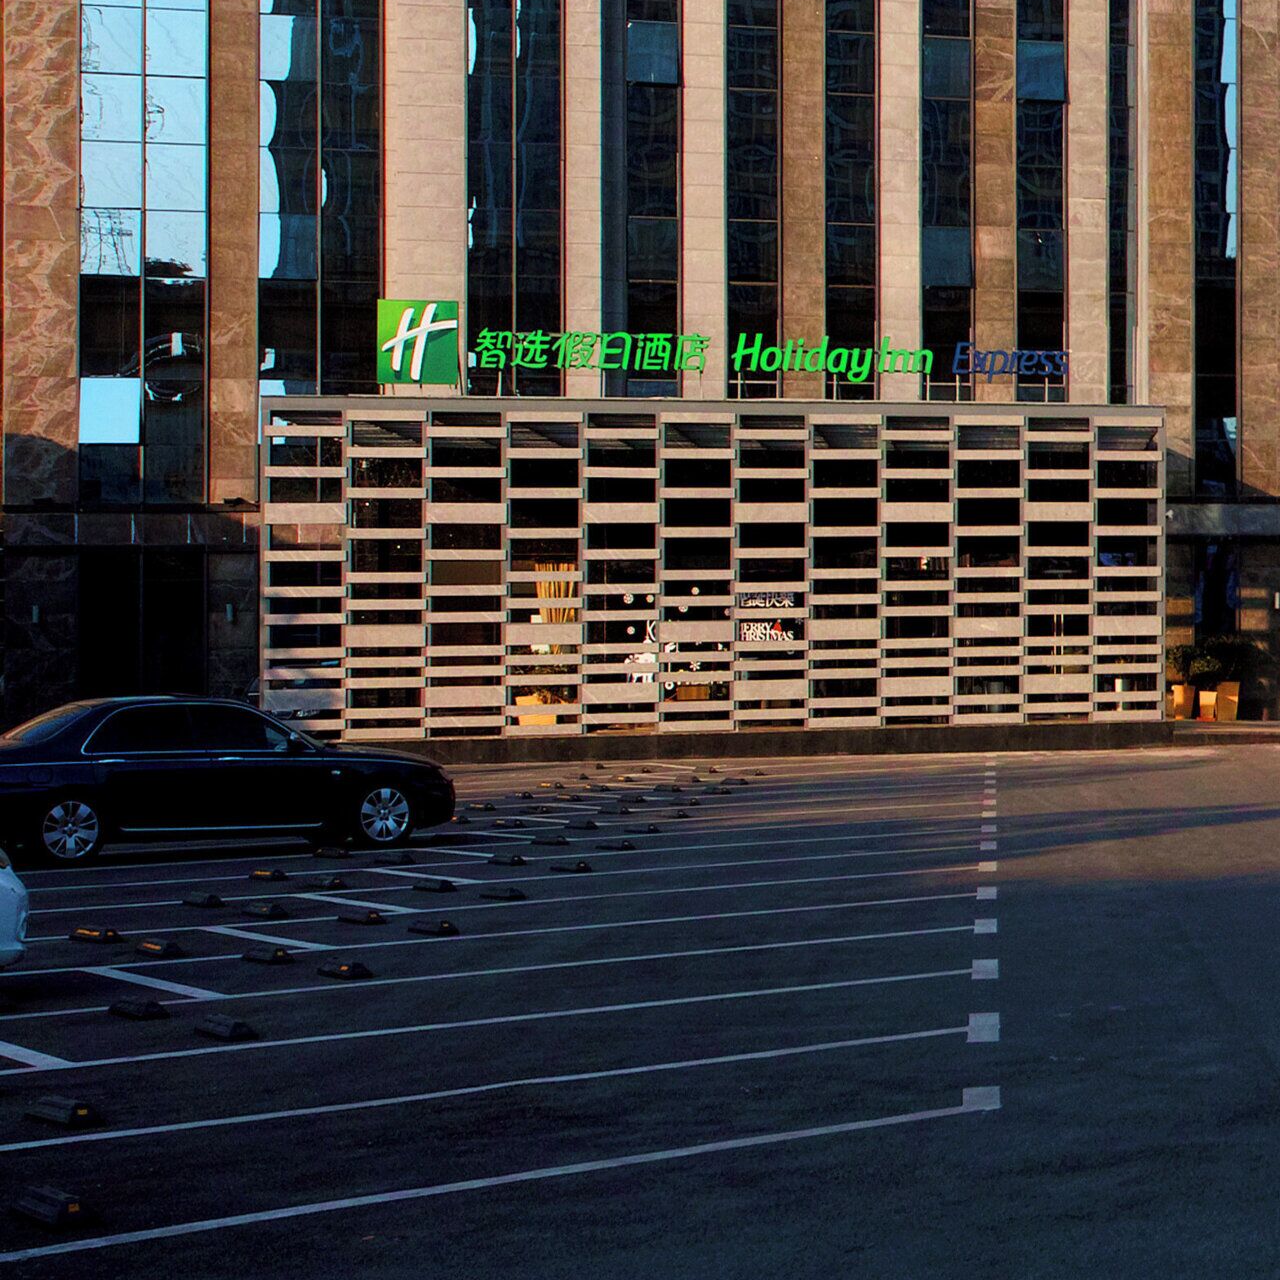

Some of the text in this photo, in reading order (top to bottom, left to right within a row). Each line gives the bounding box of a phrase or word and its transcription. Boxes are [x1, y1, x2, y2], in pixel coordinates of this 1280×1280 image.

[474, 327, 709, 371] 智选假日酒店
[731, 332, 1070, 384] Holiday Inn Express
[740, 630, 795, 641] HRISTMAS
